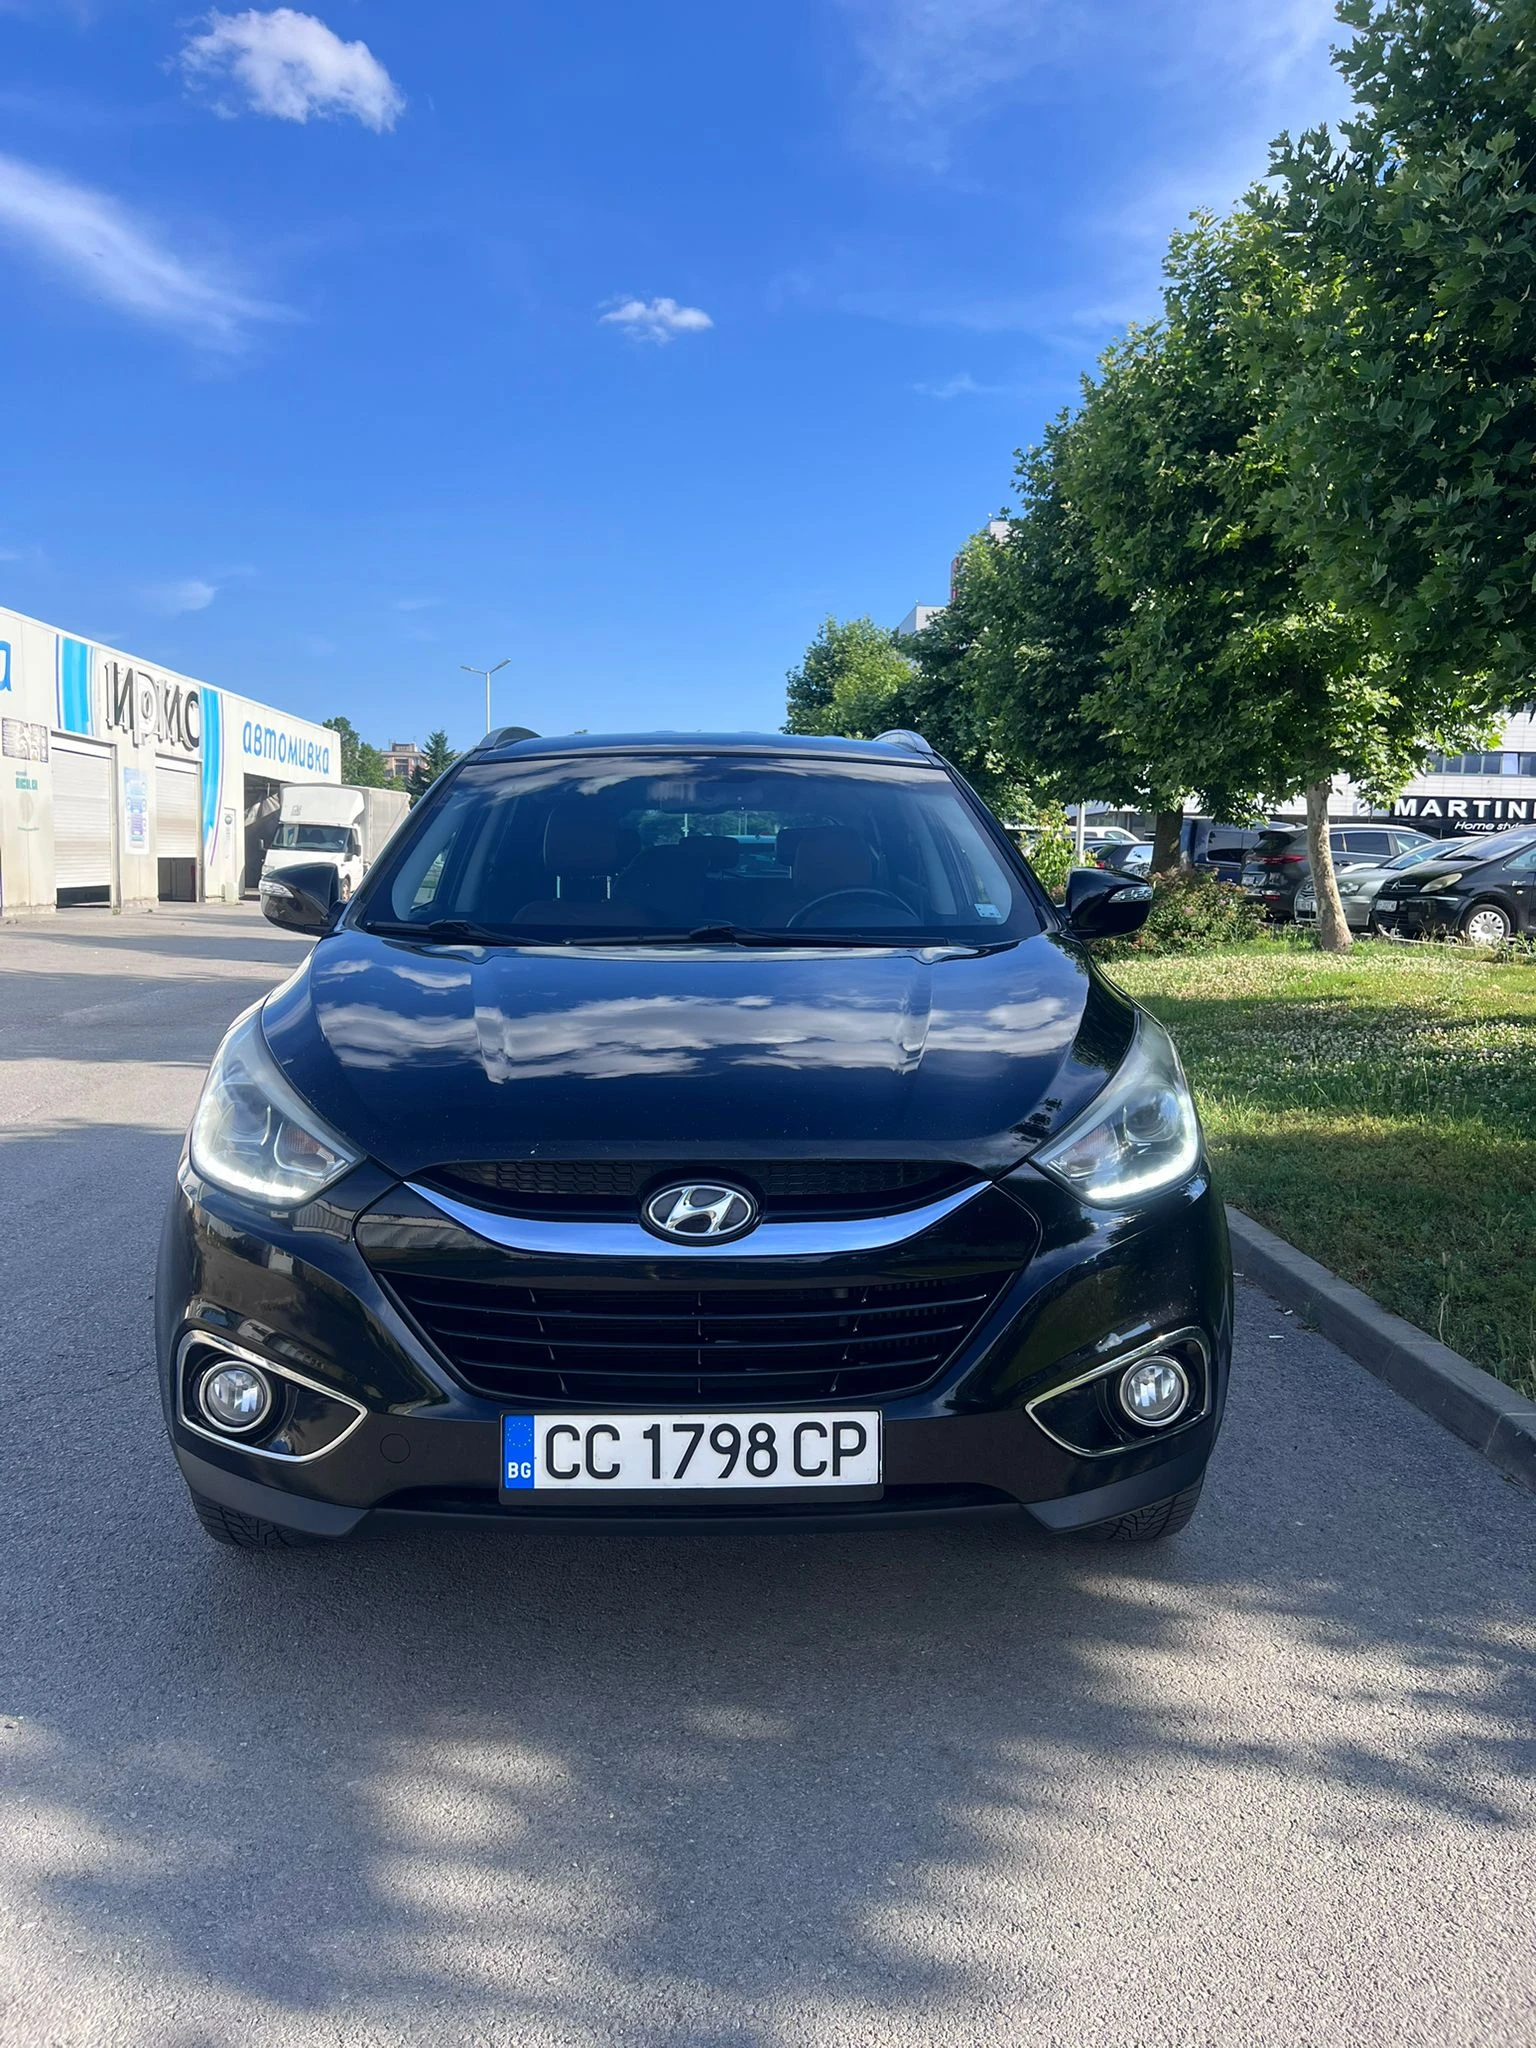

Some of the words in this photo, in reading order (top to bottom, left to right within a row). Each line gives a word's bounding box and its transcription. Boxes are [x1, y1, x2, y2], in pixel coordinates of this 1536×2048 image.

[242, 720, 330, 774] автомивка
[1454, 821, 1495, 830] Home
[545, 1424, 621, 1480] CC
[642, 1422, 778, 1480] 1798
[792, 1421, 867, 1478] CP
[507, 1461, 532, 1479] BG
